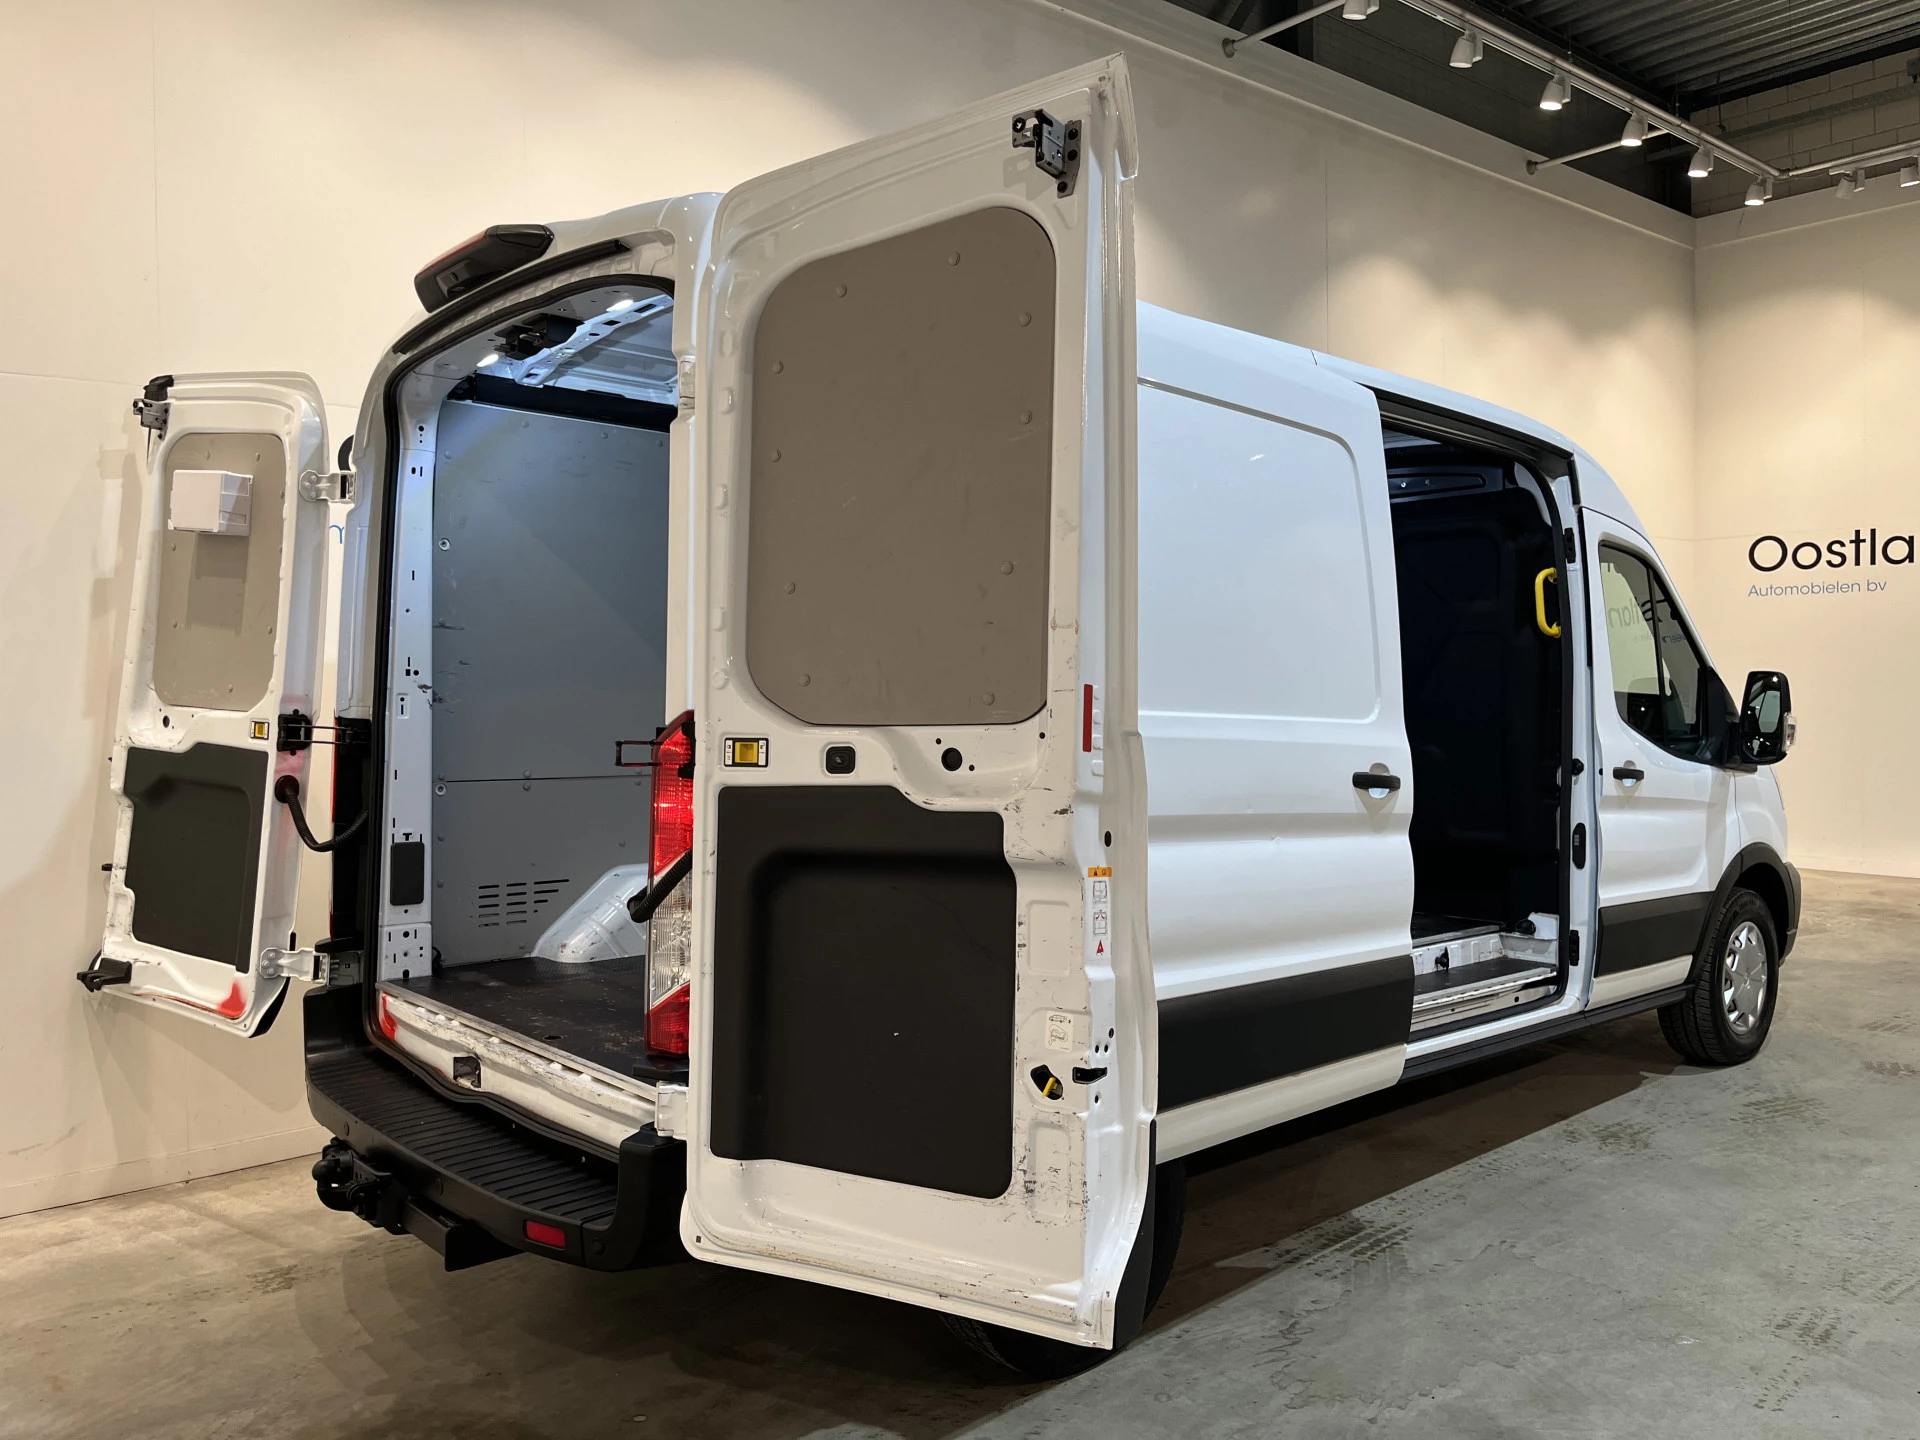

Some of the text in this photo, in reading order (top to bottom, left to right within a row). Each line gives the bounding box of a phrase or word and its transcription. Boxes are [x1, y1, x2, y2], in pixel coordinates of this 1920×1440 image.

[1748, 528, 1915, 572] Oostla
[1748, 579, 1887, 597] Automobielen bv
